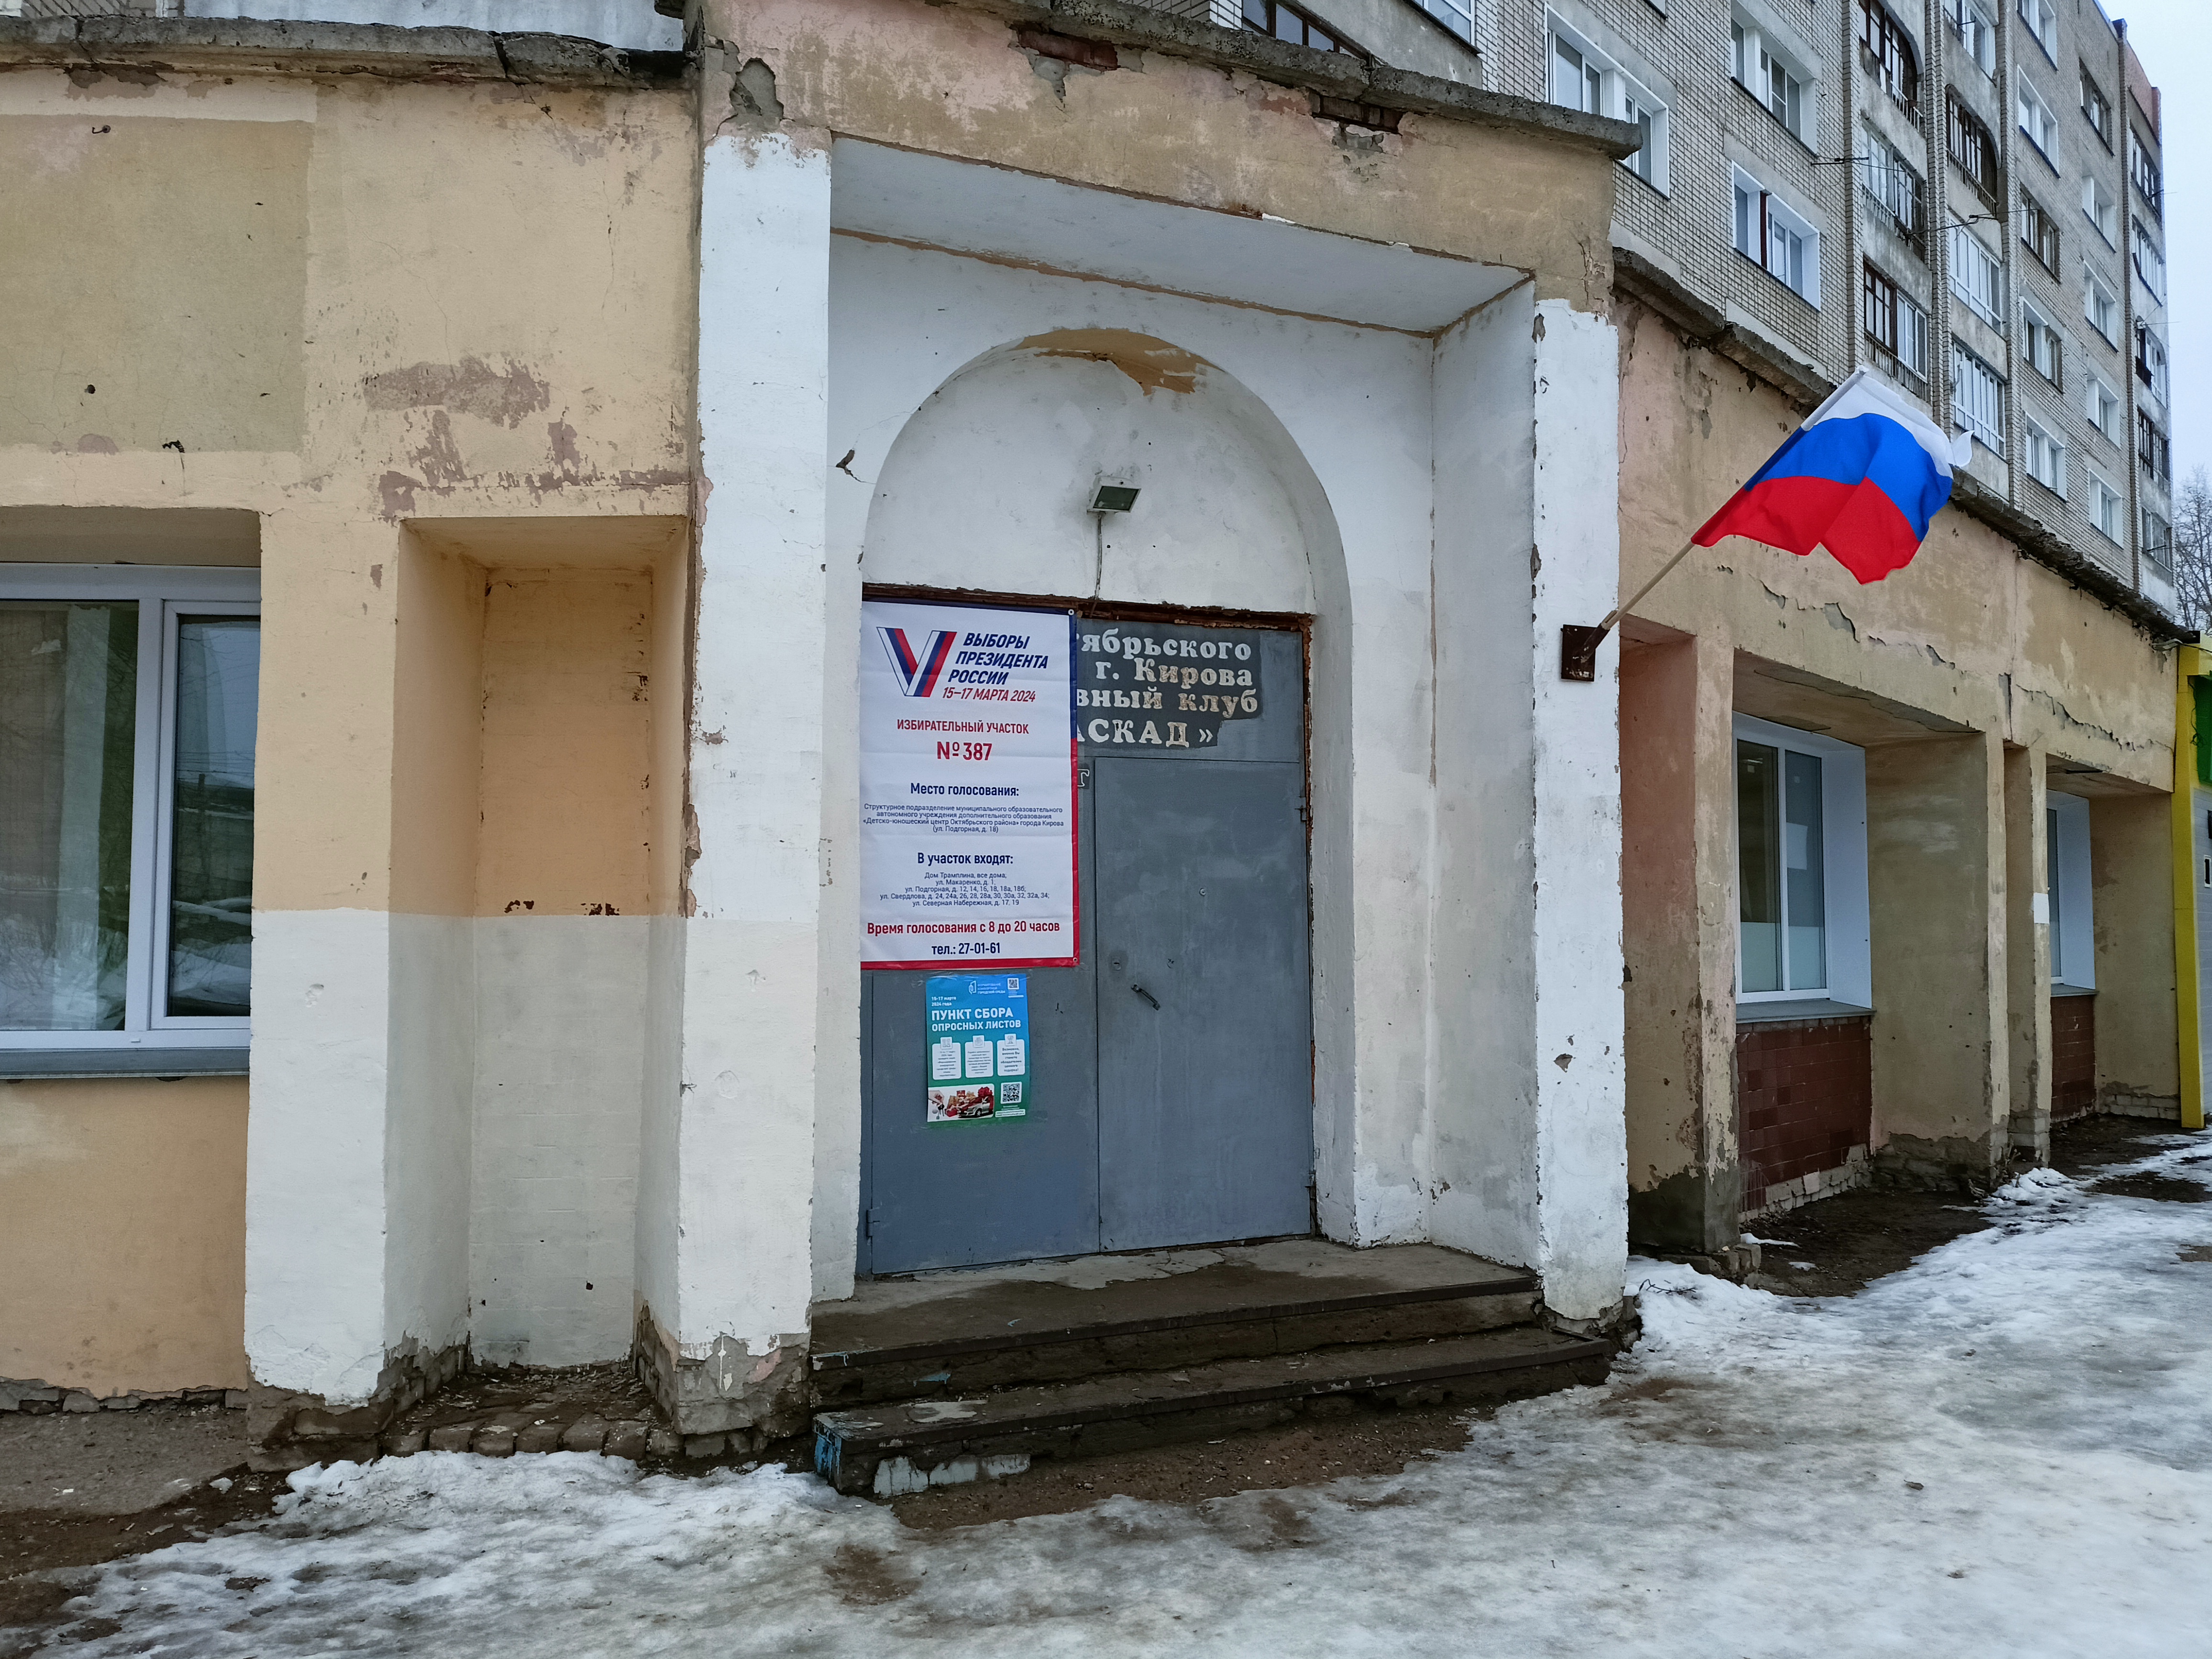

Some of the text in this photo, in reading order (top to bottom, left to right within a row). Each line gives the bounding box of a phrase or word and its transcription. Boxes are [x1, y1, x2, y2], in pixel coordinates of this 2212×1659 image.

[963, 632, 1030, 649] ВЫБОРЫ
[1076, 628, 1251, 661] ябрьского
[955, 651, 1049, 669] ПРЕЗИДЕНТА
[948, 669, 1009, 685] РОССИИ
[1095, 657, 1253, 689] г. Кирова
[973, 688, 1009, 701] МАРТА
[1010, 690, 1036, 702] 2024
[1178, 688, 1258, 718] клуб
[897, 719, 1029, 734] ИЗБИРАТЕЛЬНЫЙ УЧАСТОК
[911, 783, 1019, 796] Место голосования:
[918, 852, 1013, 866] В участок входят:
[867, 920, 1060, 937] Время голосования с 8 до 20 часов
[931, 942, 1000, 955] тел.: 27-01-61
[932, 1007, 1014, 1021] ПУНКТ СБОРА
[932, 1019, 1021, 1031] ОПРОСНЫХ ЛИСТОВ
